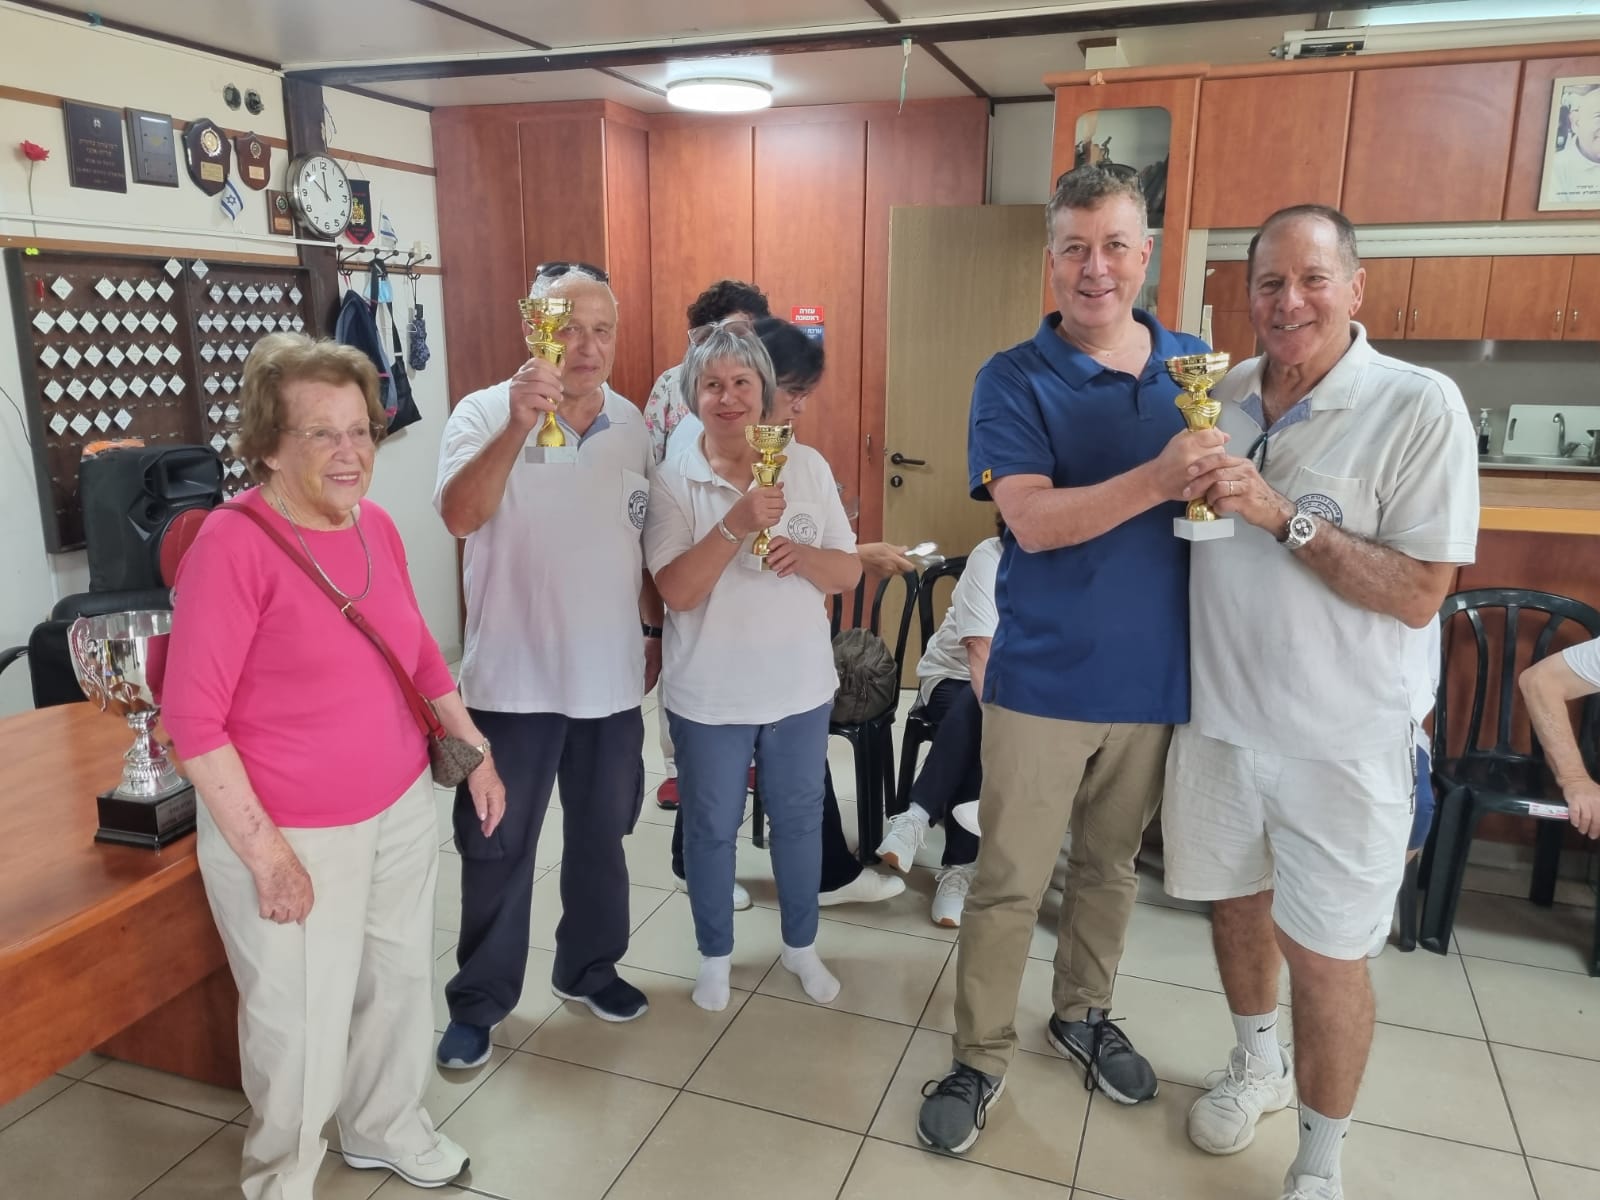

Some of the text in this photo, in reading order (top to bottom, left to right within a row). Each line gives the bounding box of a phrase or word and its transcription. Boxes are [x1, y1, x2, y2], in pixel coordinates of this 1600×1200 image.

[312, 163, 316, 172] 11
[320, 161, 327, 171] 12
[338, 179, 344, 188] 2
[302, 189, 308, 197] 9
[342, 194, 348, 203] 3
[306, 204, 312, 213] 8
[314, 216, 319, 224] 7
[334, 219, 340, 227] 5
[324, 222, 330, 230] 6
